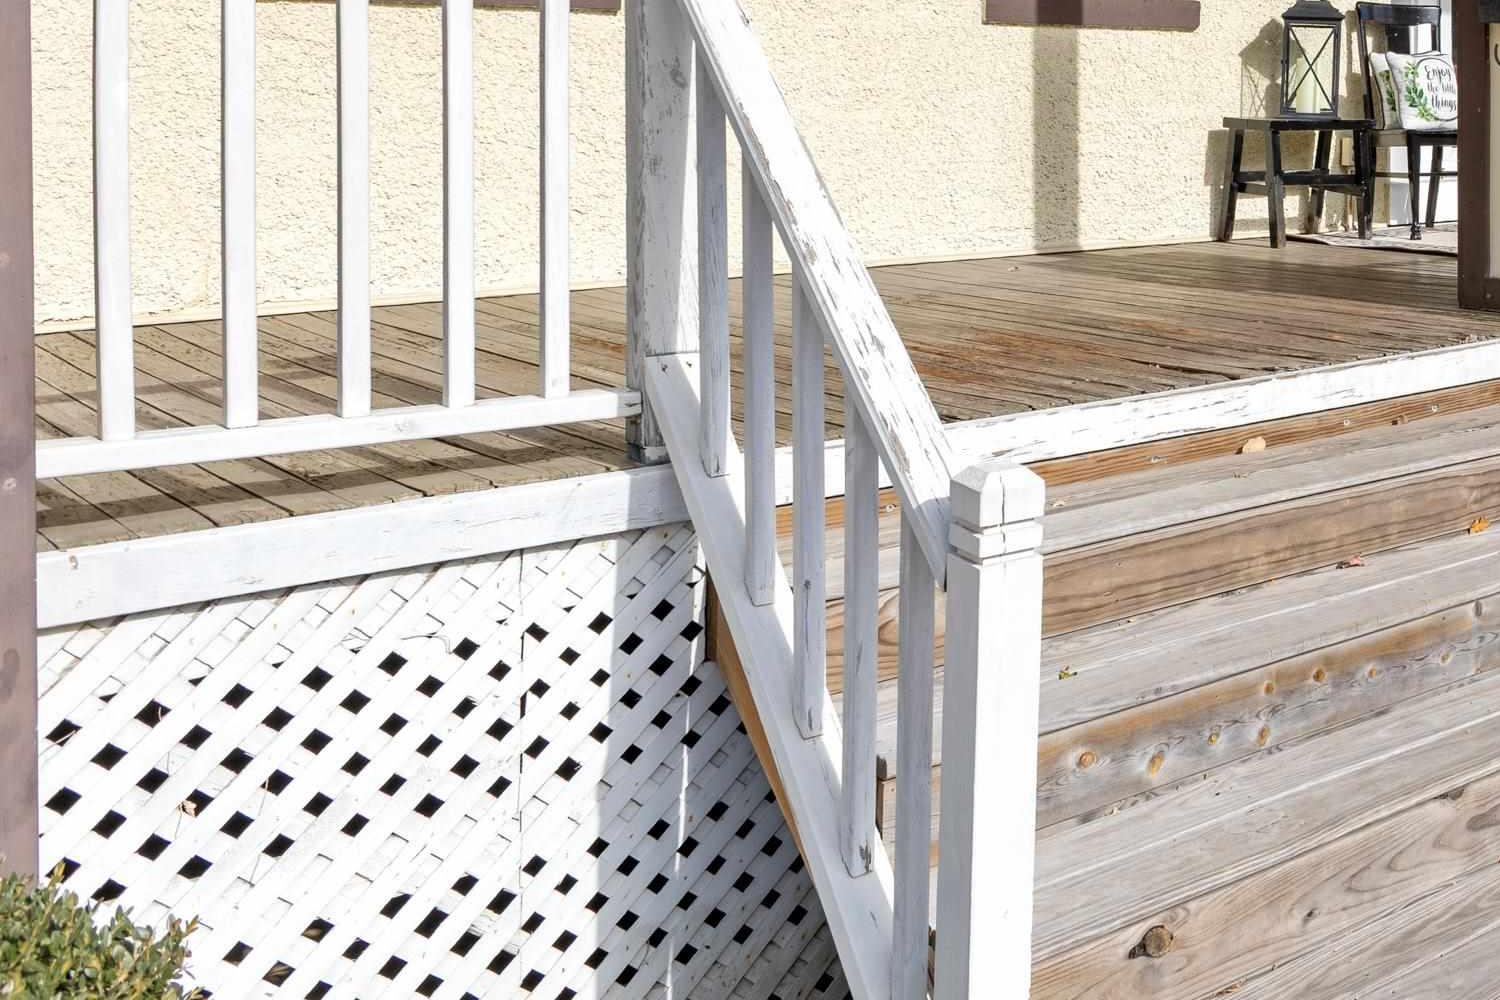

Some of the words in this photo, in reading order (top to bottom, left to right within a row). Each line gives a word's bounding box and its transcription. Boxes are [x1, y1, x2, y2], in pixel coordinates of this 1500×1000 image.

[1424, 65, 1451, 83] Enjoy
[1427, 82, 1440, 94] the
[1431, 94, 1457, 113] things
